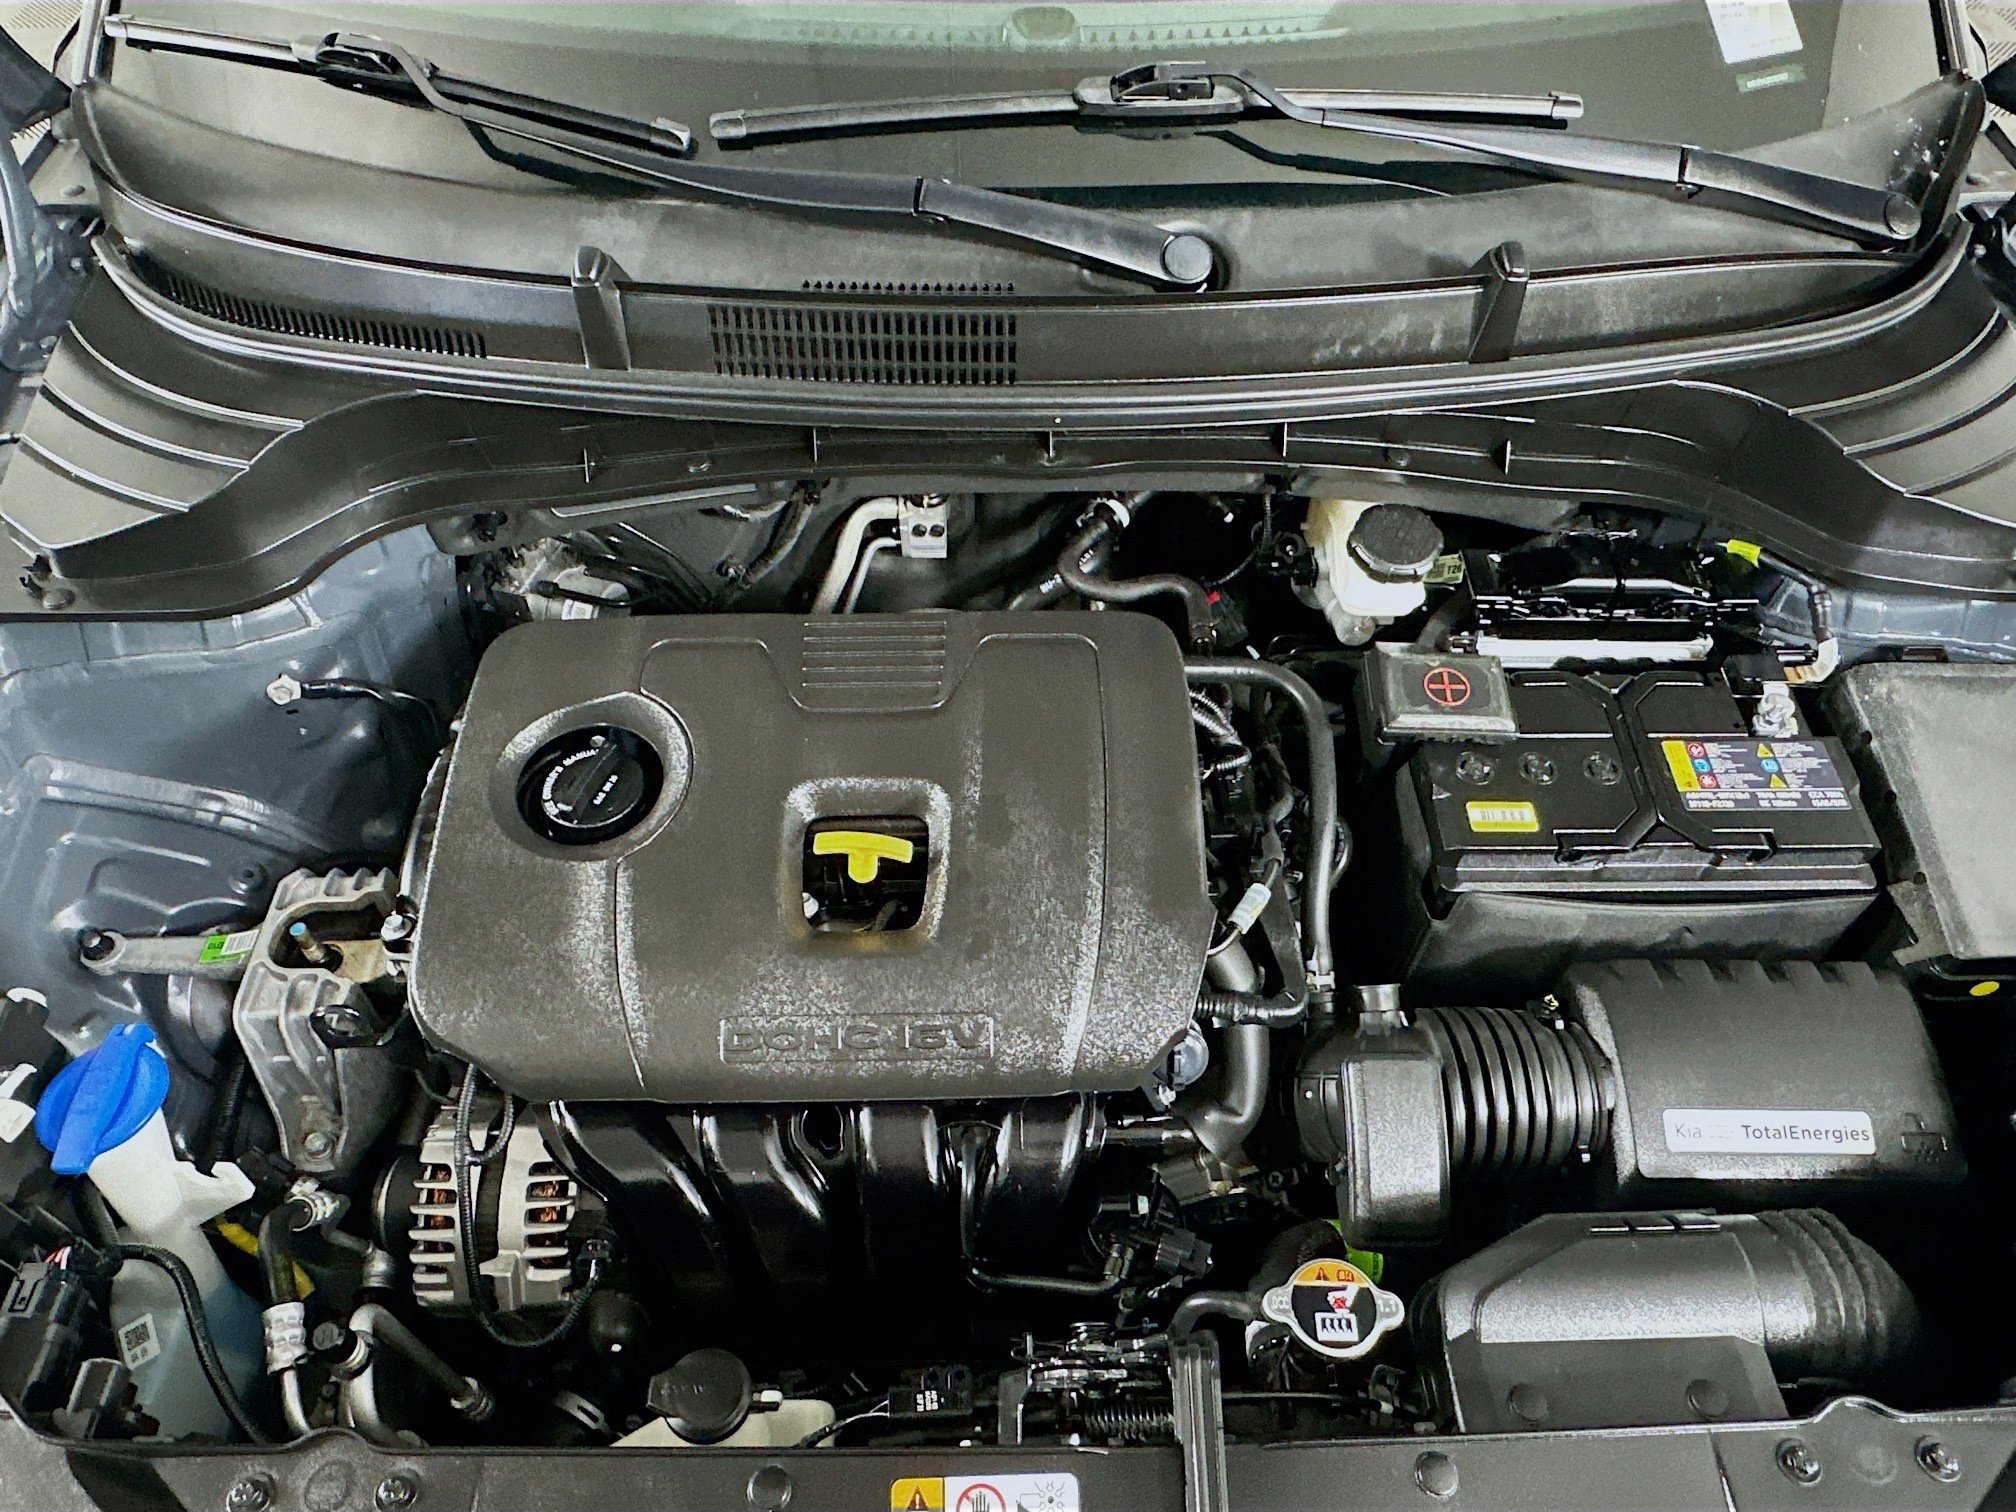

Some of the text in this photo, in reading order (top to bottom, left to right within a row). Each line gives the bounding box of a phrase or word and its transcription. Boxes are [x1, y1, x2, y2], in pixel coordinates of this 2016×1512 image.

[725, 1024, 881, 1050] DOHC
[1675, 1123, 1870, 1143] Kia TotalEnergies
